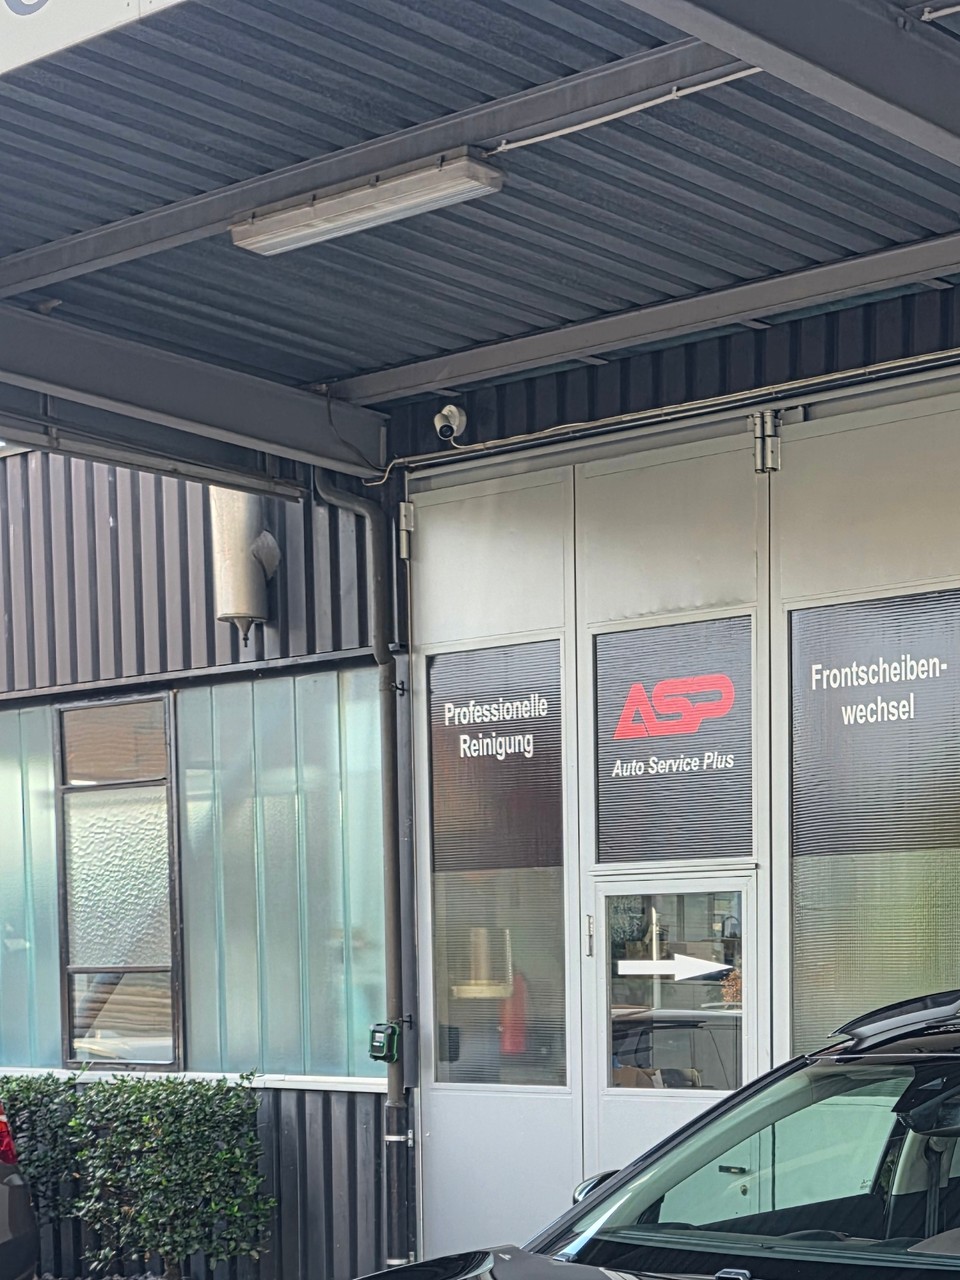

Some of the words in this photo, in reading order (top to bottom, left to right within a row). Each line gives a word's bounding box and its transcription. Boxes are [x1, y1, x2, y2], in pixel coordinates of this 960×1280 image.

[811, 653, 948, 691] Frontscheiben-
[444, 693, 549, 726] Professionelle
[612, 673, 735, 740] ASP
[840, 692, 916, 726] wechsel
[459, 731, 534, 761] Reinigung
[611, 758, 645, 778] Auto
[647, 754, 700, 775] Service
[702, 751, 735, 770] Plus
